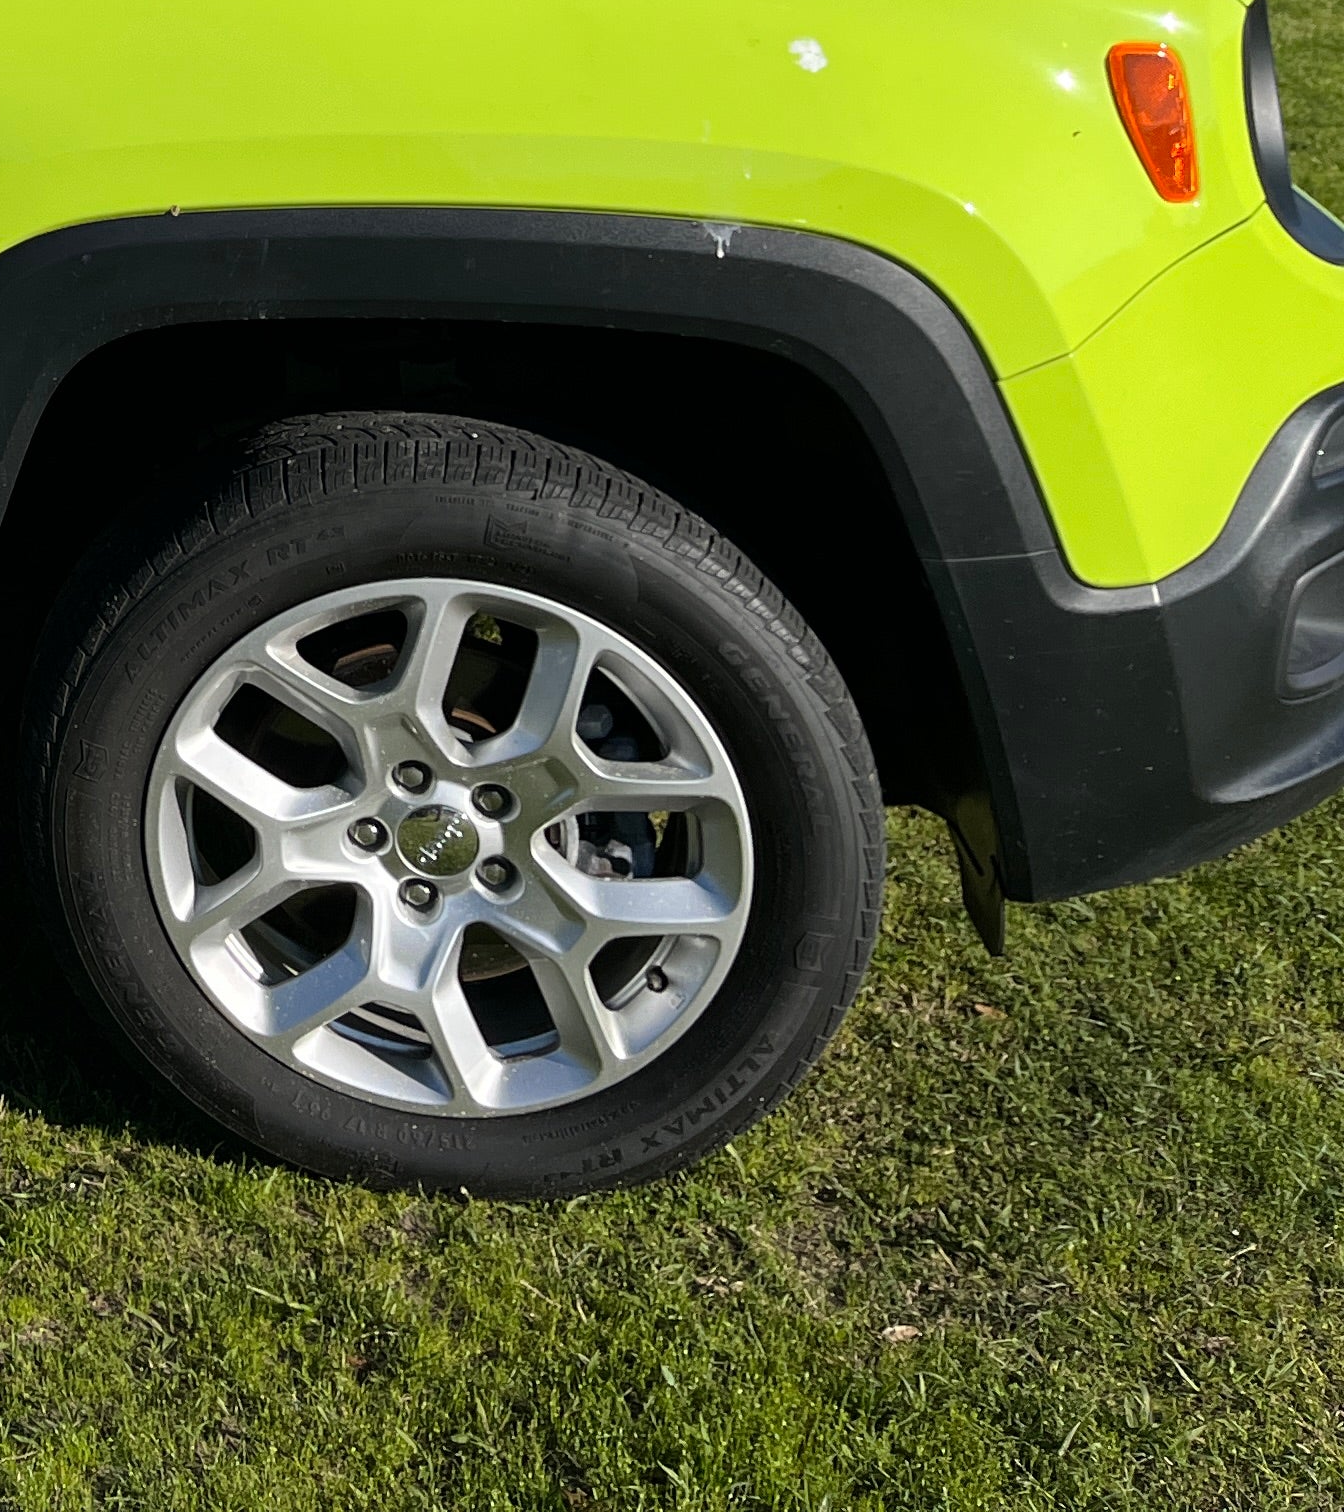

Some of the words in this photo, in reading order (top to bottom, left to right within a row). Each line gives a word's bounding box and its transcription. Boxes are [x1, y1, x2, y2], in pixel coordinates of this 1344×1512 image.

[124, 558, 252, 685] ALTIMAX
[716, 638, 833, 835] GENERAL
[640, 1032, 776, 1154] ALTIMAX
